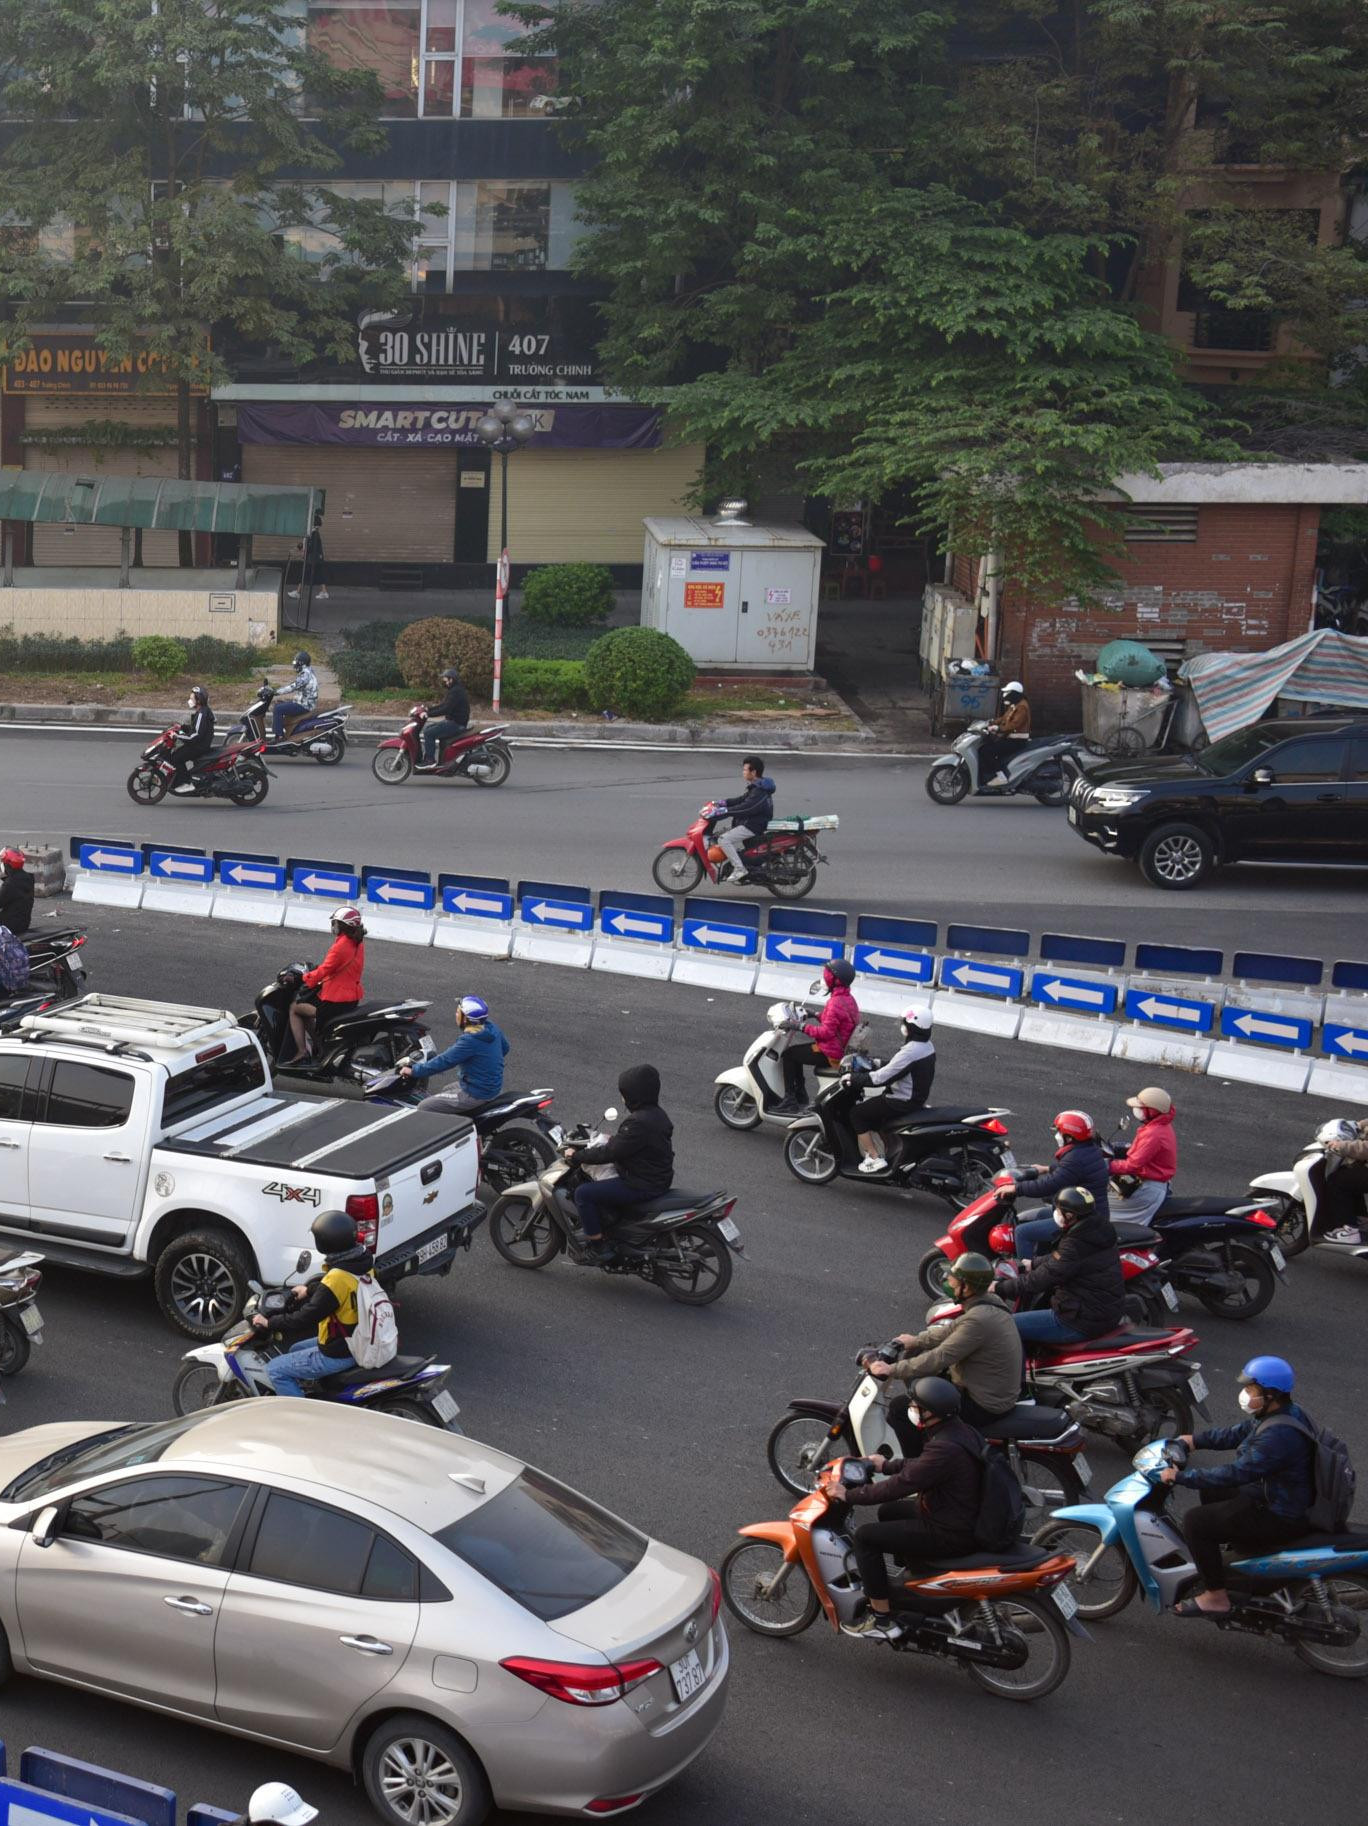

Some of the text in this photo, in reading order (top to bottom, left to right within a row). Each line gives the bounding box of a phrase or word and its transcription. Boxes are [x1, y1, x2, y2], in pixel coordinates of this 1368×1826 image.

[379, 329, 486, 365] 30 SHINE
[508, 334, 550, 355] 407
[57, 349, 132, 373] NGUYN
[508, 362, 592, 376] TRƯỜNG CHINH
[524, 387, 541, 400] CẮT
[565, 390, 590, 400] NAM
